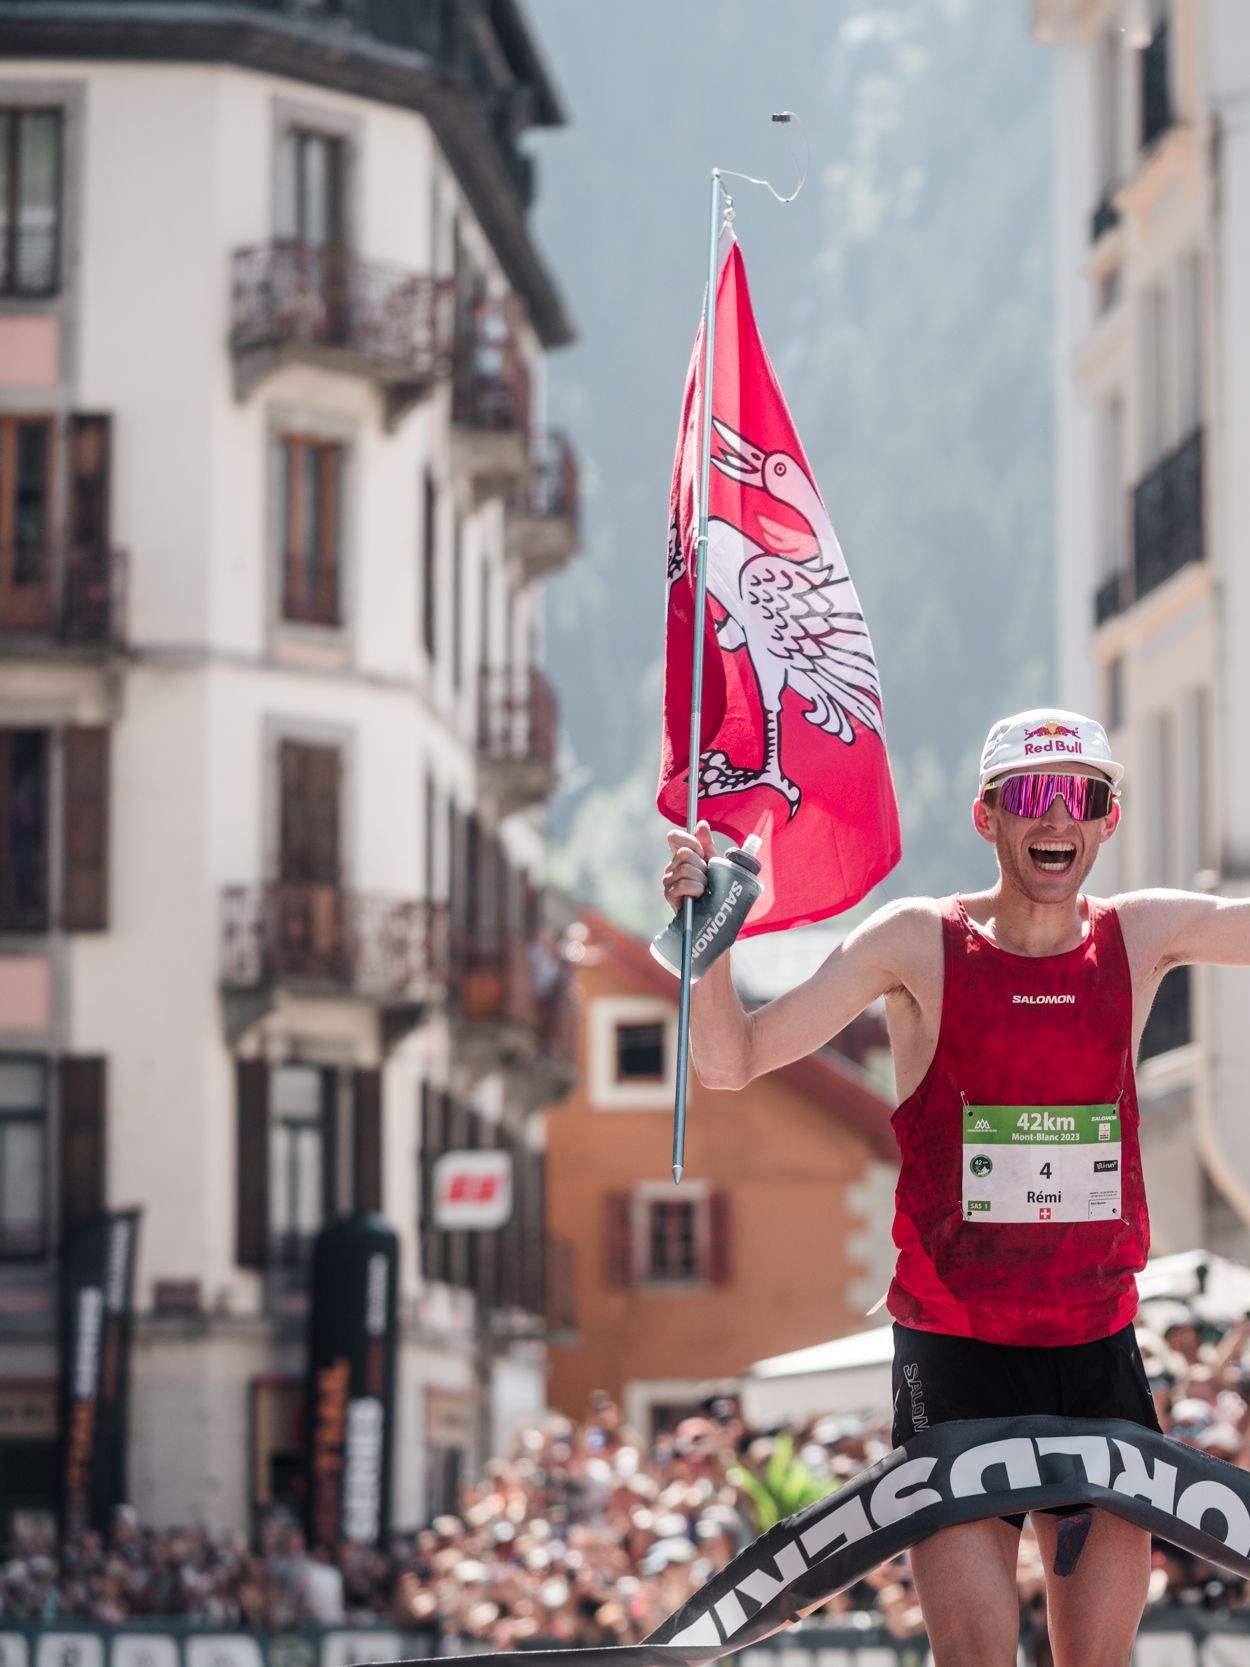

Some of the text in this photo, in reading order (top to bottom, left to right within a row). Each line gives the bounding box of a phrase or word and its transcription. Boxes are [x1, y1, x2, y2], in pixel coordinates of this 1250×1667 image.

[1024, 740, 1082, 755] Red Bull
[1012, 995, 1076, 1004] SALOMON
[1017, 1112, 1075, 1131] 42km
[1011, 1132, 1080, 1141] Mont-Blanc 2023
[1039, 1162, 1053, 1179] 4
[1027, 1191, 1062, 1203] Rémi
